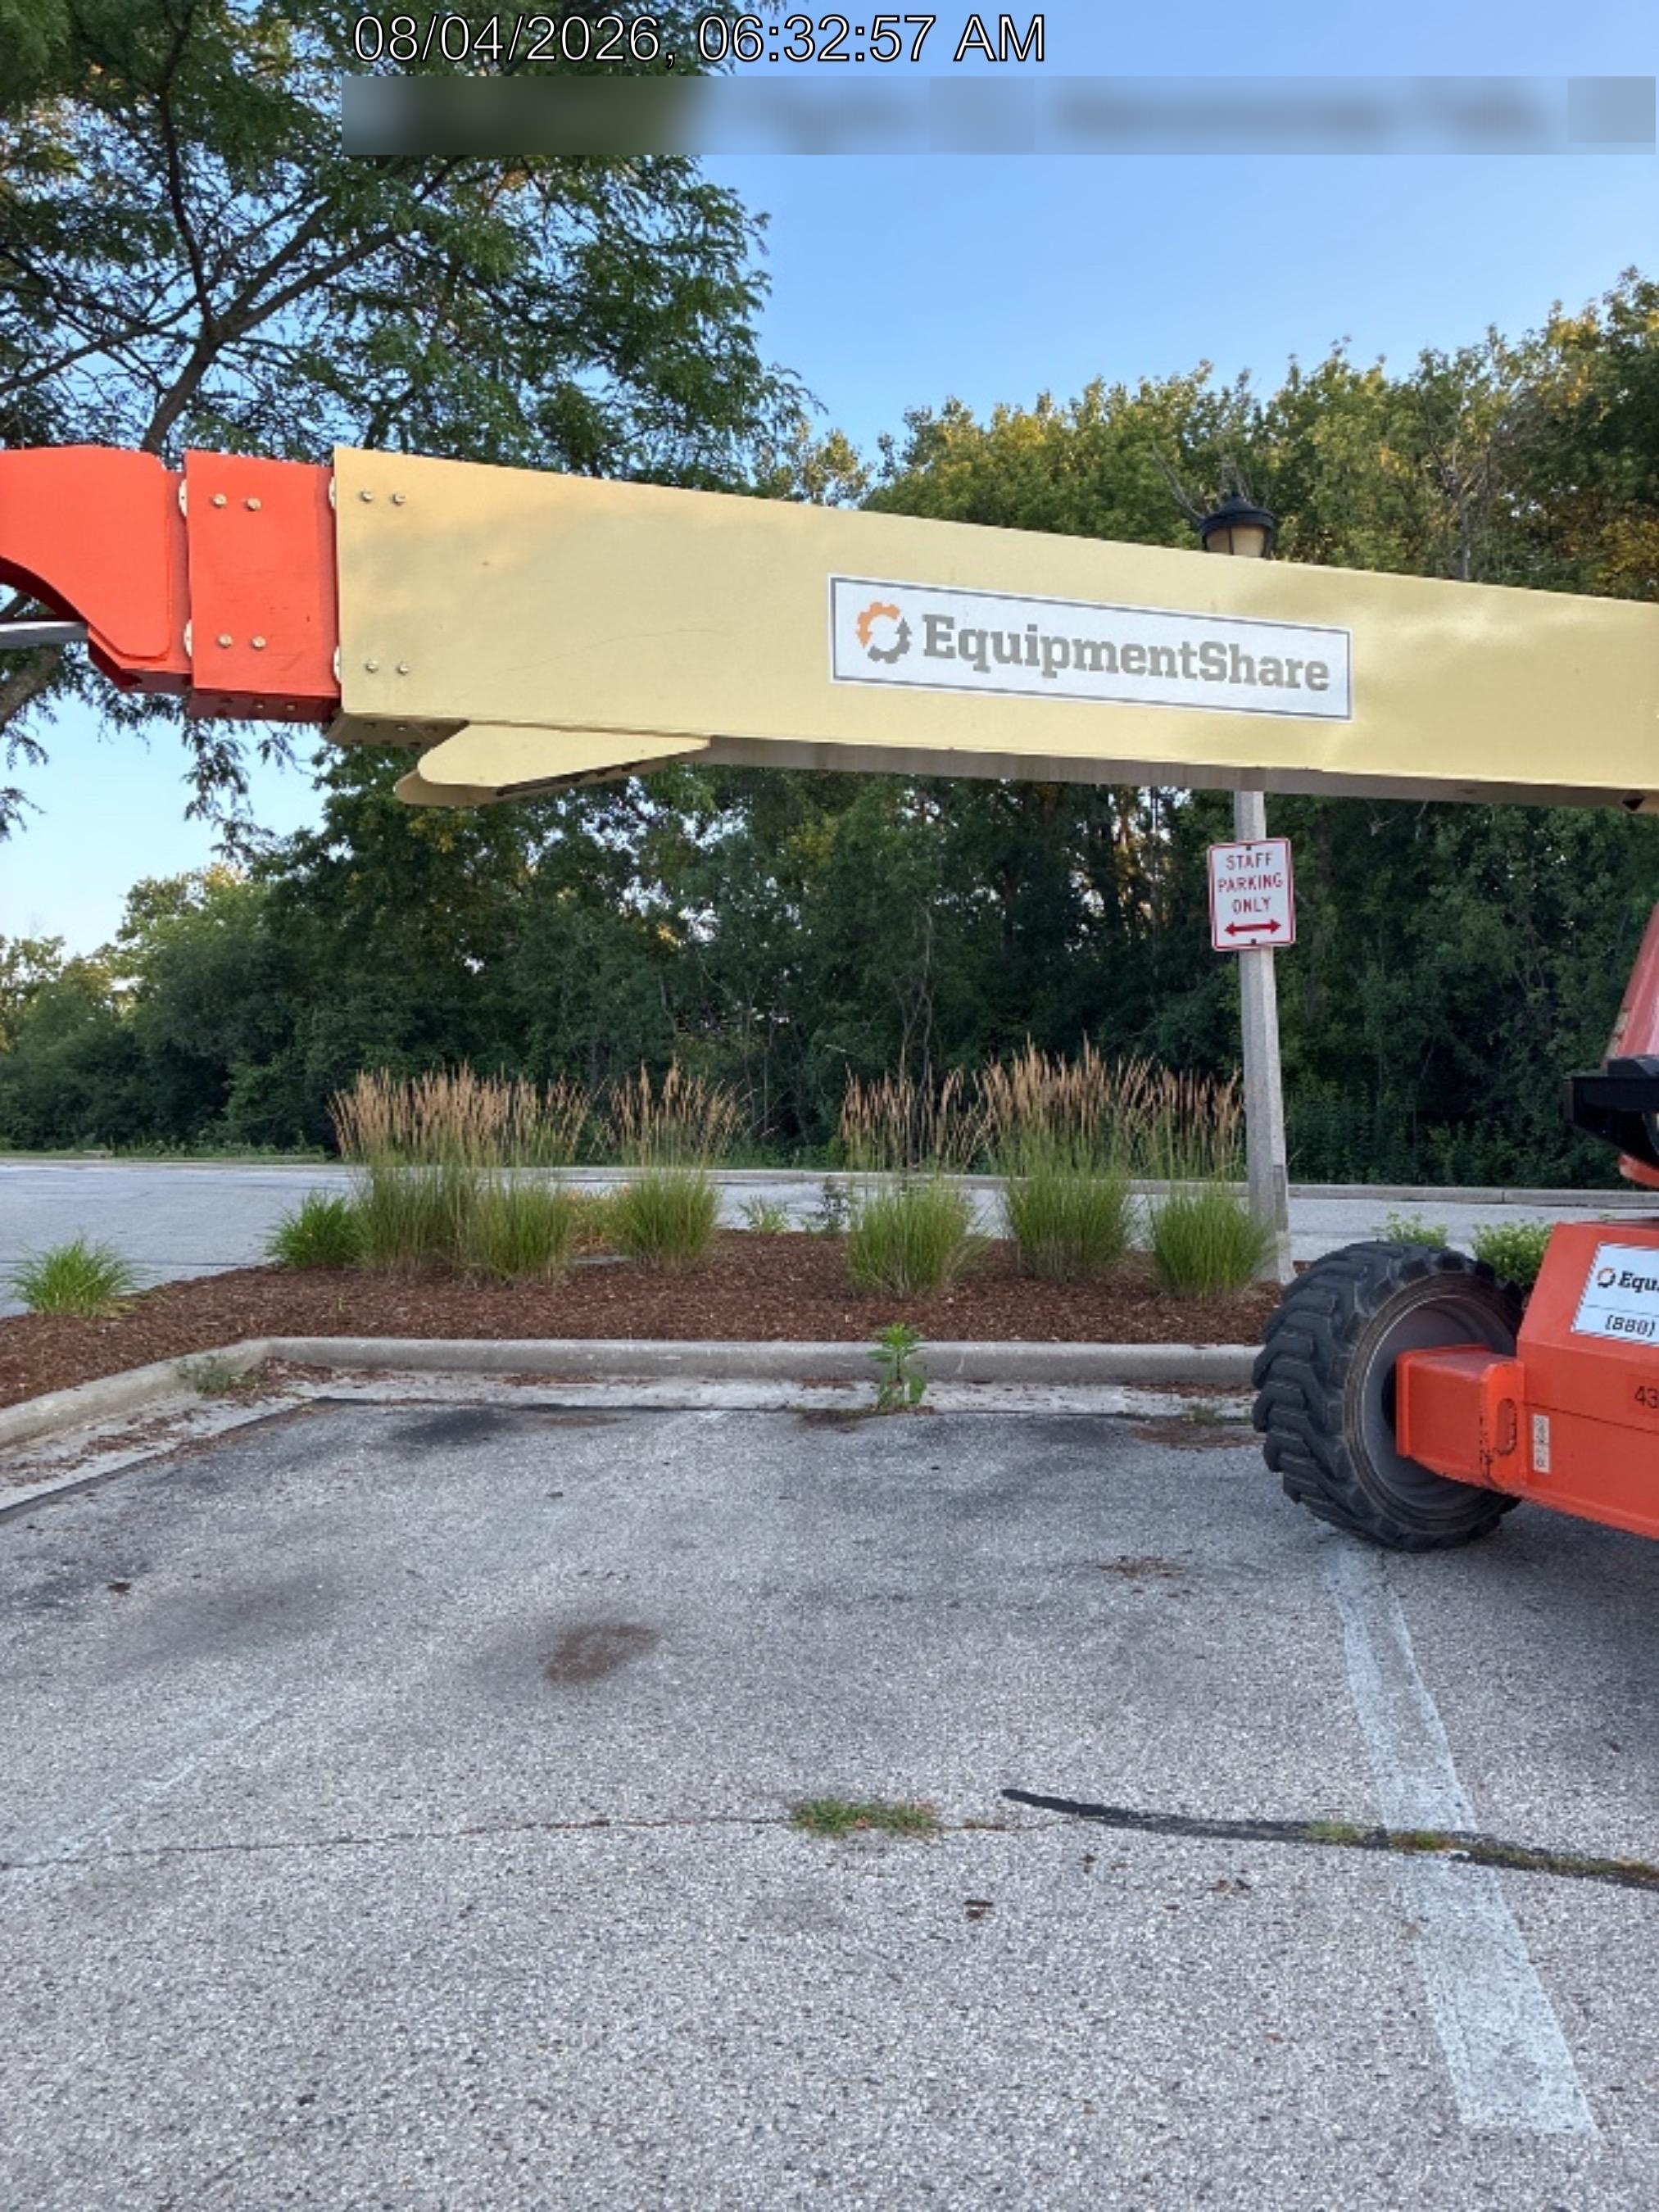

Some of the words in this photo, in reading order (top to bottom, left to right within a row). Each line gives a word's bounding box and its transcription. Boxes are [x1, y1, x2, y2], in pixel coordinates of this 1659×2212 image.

[922, 614, 1329, 691] EquipmentShare
[1226, 852, 1272, 870] STAFF
[1217, 873, 1284, 893] PARKING
[1232, 896, 1271, 914] ONLY
